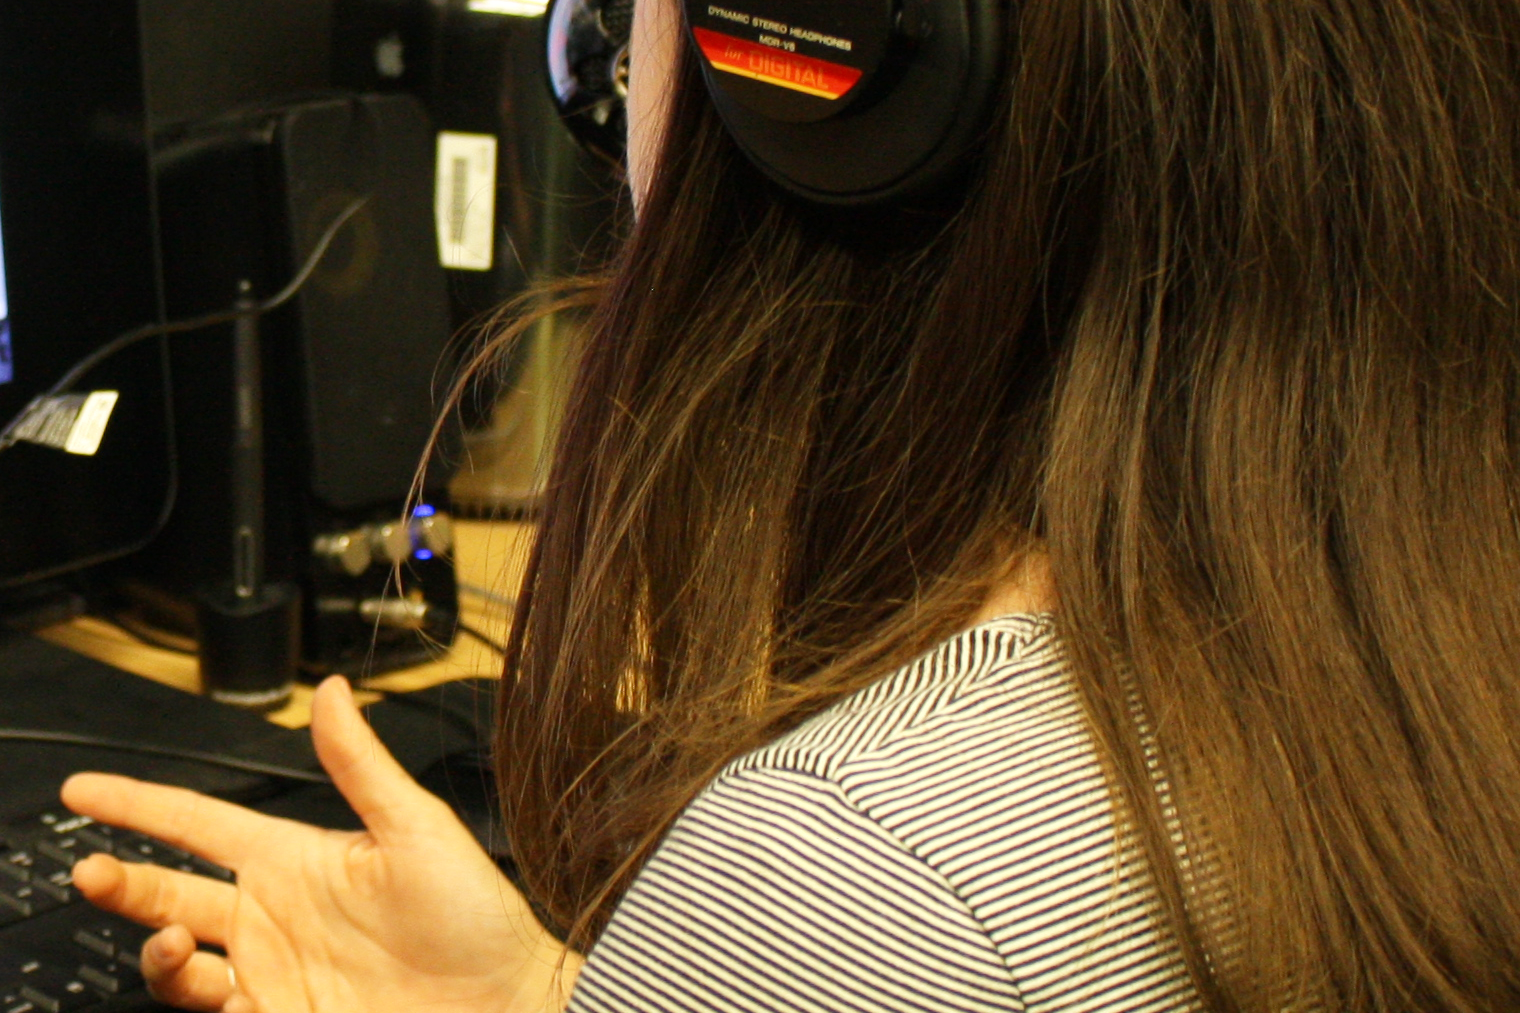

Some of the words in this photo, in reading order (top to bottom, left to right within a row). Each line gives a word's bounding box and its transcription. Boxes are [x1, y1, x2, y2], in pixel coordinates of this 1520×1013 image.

[708, 5, 750, 25] DYNAMIC
[751, 16, 788, 35] STEREO
[789, 27, 853, 51] HEADPHONES
[748, 50, 829, 89] DIGITAL
